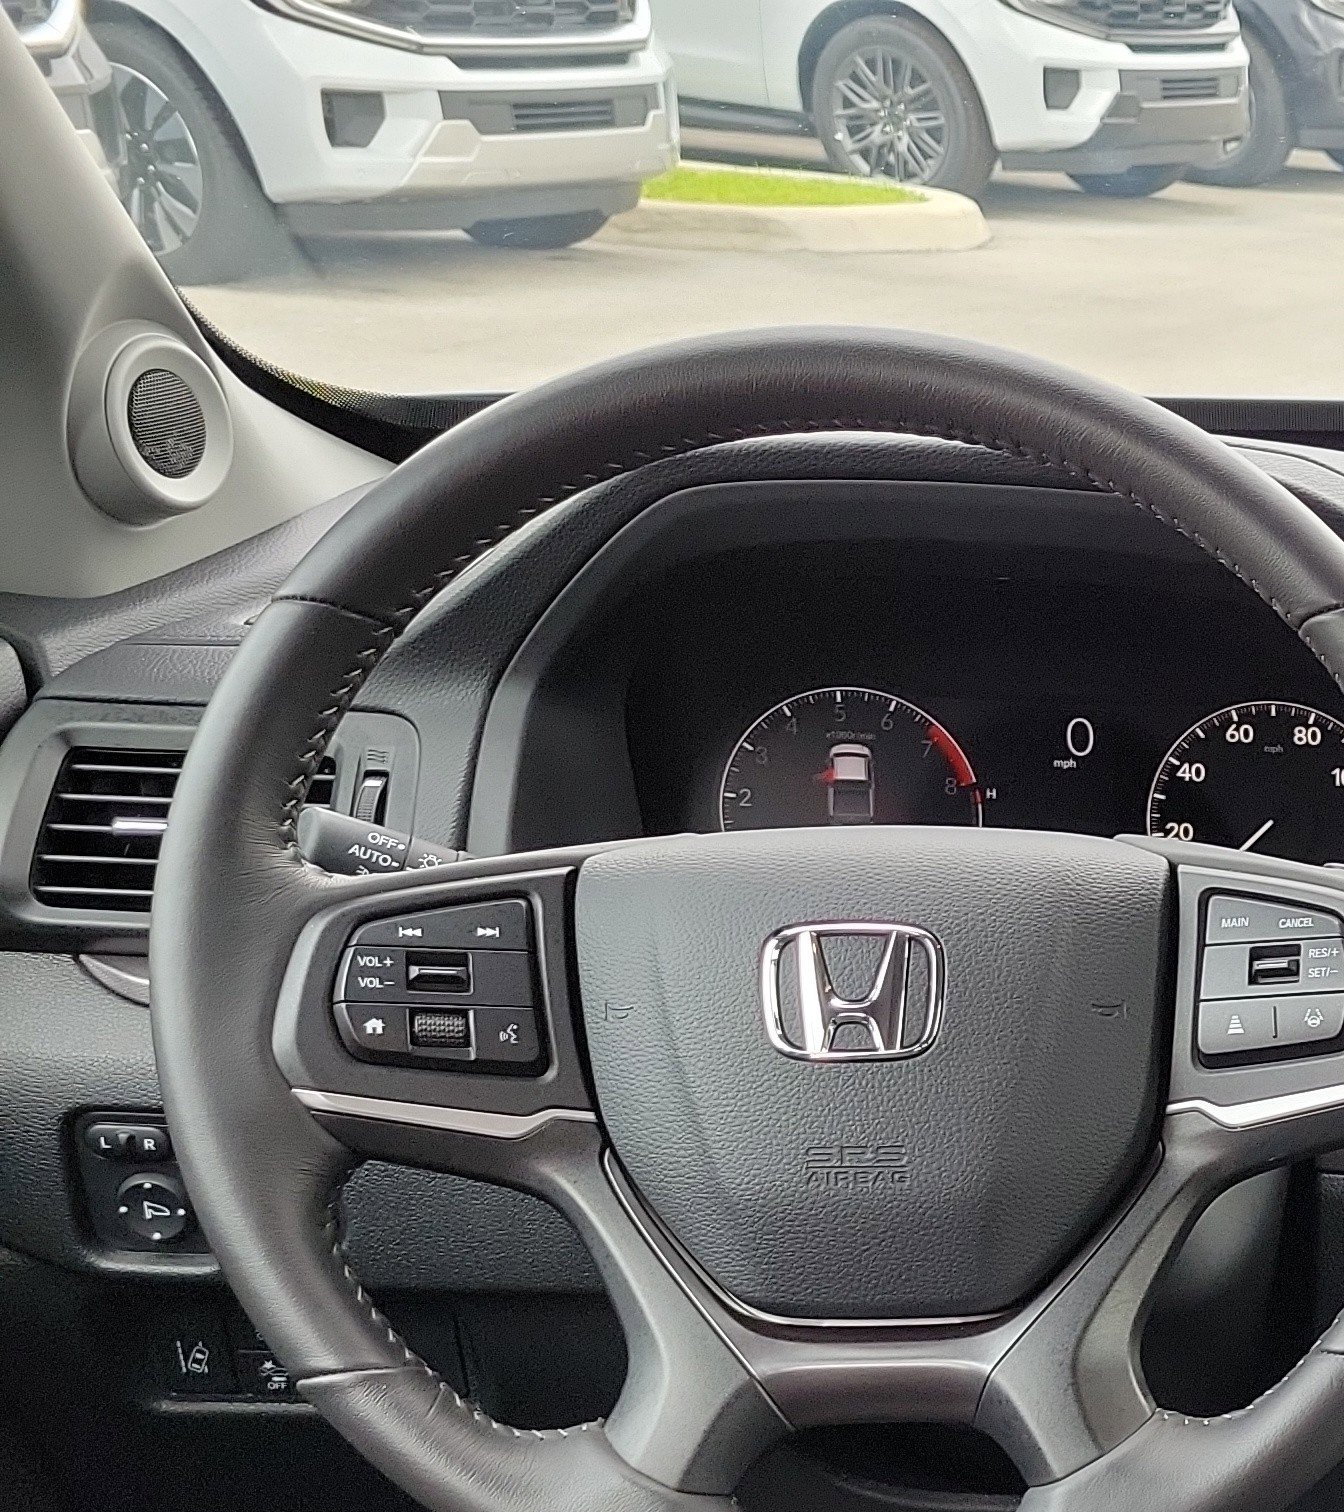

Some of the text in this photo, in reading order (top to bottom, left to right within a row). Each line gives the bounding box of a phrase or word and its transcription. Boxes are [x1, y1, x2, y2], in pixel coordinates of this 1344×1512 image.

[835, 704, 847, 722] 5
[881, 713, 894, 731] 6
[786, 717, 798, 734] 4
[1225, 724, 1254, 743] 60
[1066, 718, 1095, 757] 0
[1293, 726, 1322, 746] 80
[921, 740, 932, 758] 7
[1053, 758, 1077, 770] mph
[1176, 763, 1206, 783] 40
[945, 777, 957, 795] 8
[739, 789, 752, 807] 2
[1164, 822, 1194, 841] 20
[1221, 917, 1249, 928] MAIN
[1278, 917, 1315, 929] CANCEL
[100, 1136, 112, 1149] L
[144, 1138, 156, 1151] R
[267, 1381, 288, 1390] OFF
